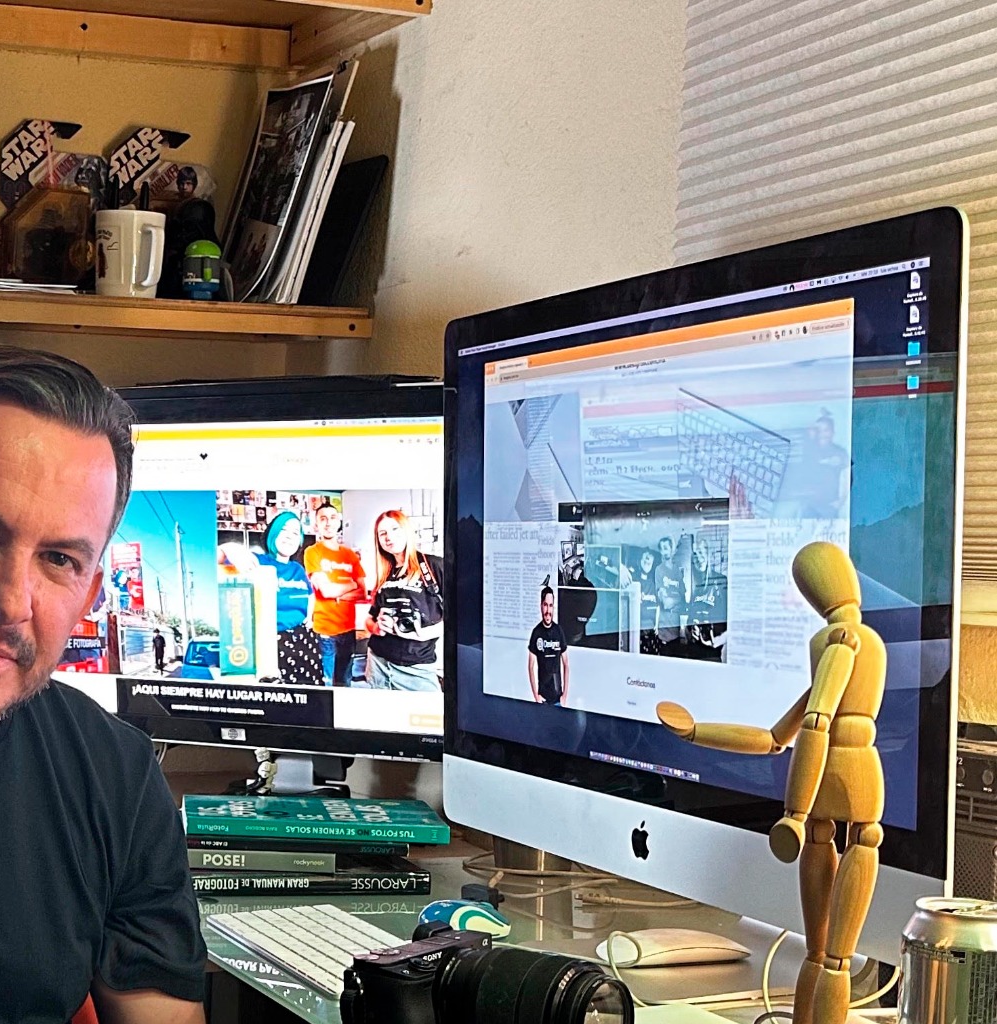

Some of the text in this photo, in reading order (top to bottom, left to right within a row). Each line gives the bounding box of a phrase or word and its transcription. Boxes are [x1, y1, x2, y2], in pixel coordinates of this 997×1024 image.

[1, 119, 54, 171] STAR
[109, 127, 162, 178] STAR
[2, 138, 49, 182] WAR
[160, 686, 204, 697] SIEMPRE
[205, 688, 226, 699] HAY
[226, 689, 263, 701] LUGAR
[264, 692, 293, 703] PARA
[285, 825, 415, 838] TUS FOTOS NO SE VENDEN SOLAS
[202, 853, 245, 867] POSE!
[193, 878, 310, 890] GRAN MANUAL DE FOTOGRAF
[351, 878, 417, 890] LAROUSSE
[423, 951, 443, 962] SONY
